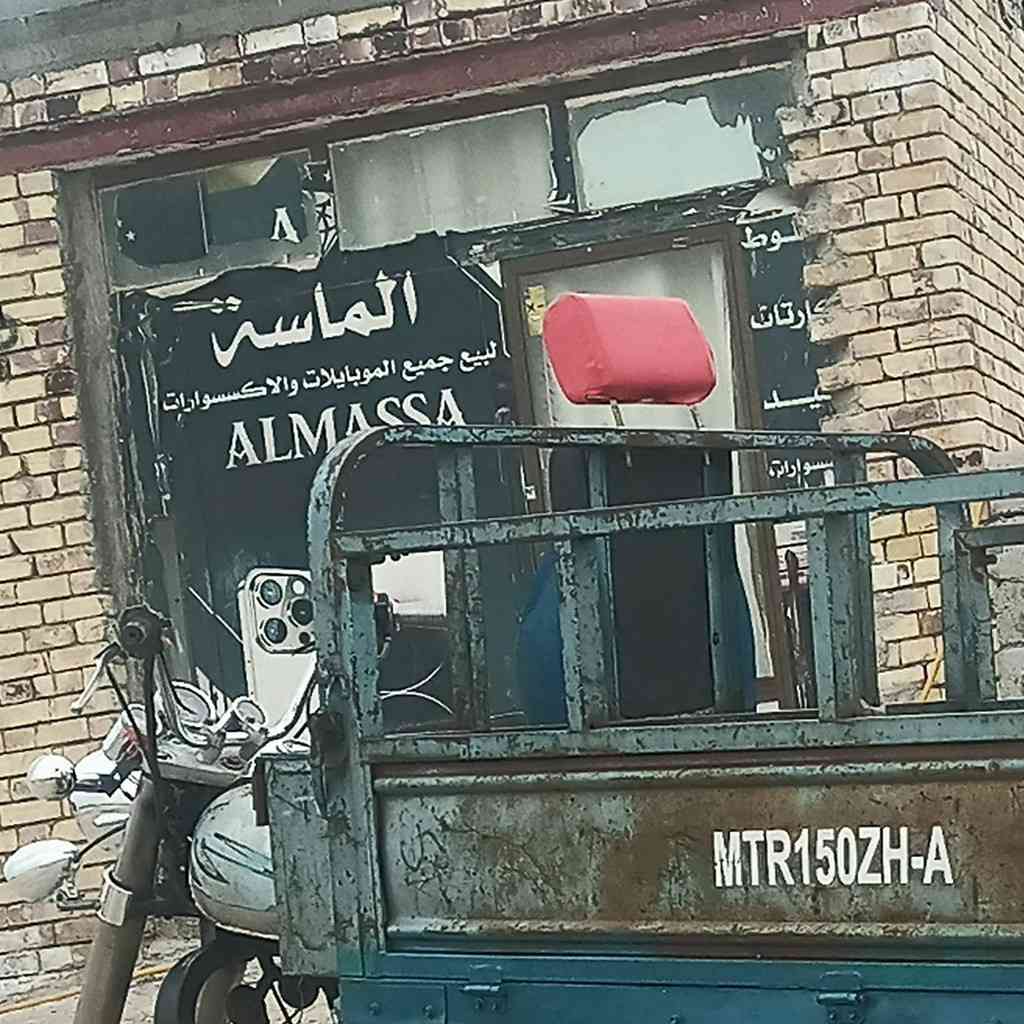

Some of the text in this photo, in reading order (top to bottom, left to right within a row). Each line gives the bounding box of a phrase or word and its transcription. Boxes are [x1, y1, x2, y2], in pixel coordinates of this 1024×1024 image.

[401, 355, 454, 382] جميع
[459, 340, 497, 372] لبيع
[302, 359, 397, 390] الموبايلات
[712, 824, 954, 888] MTR150ZH-A
